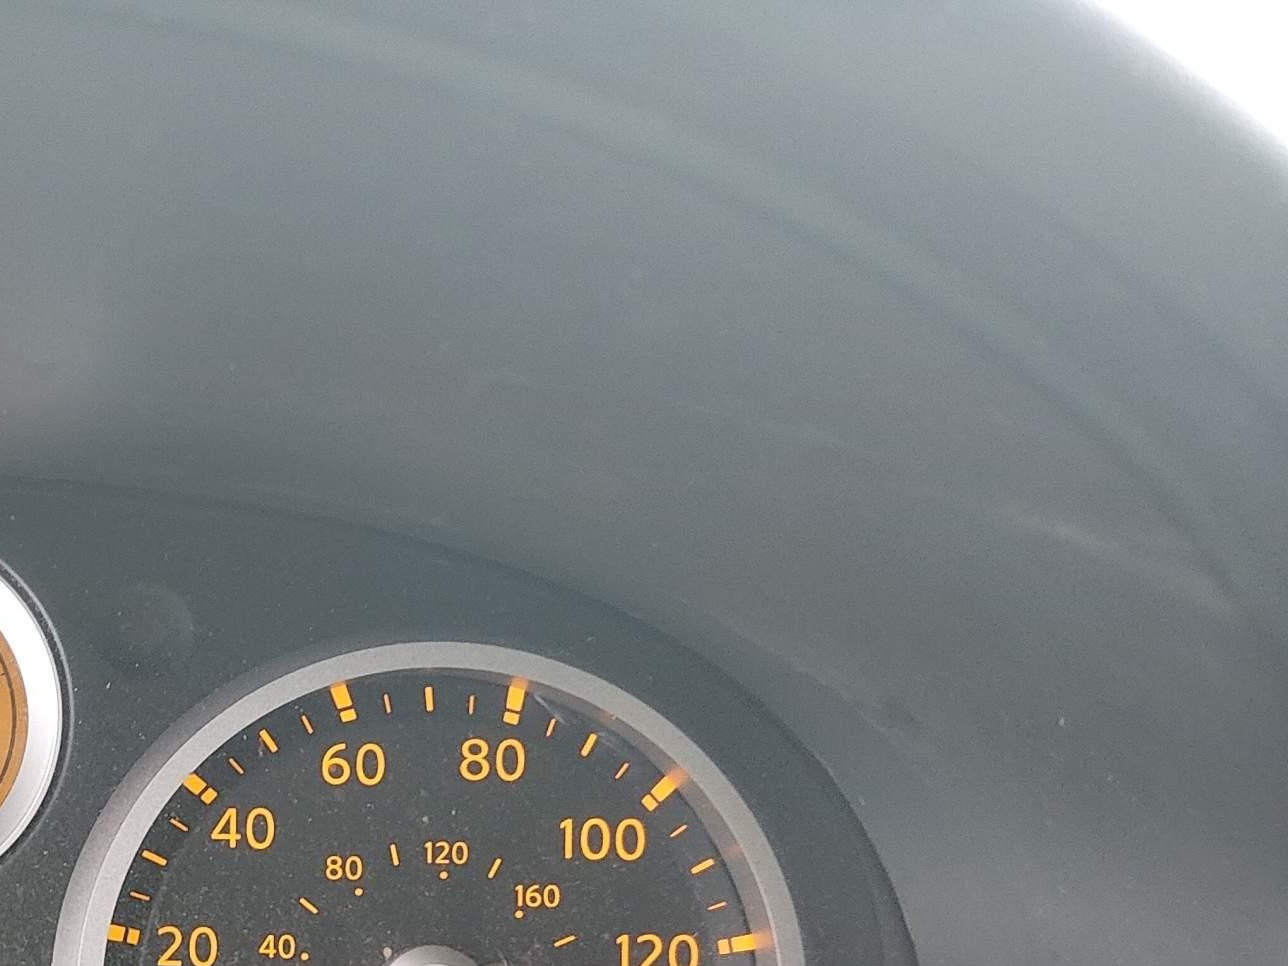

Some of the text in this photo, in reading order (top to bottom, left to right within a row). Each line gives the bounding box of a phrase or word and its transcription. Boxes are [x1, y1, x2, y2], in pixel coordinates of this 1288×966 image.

[320, 742, 386, 786] 60
[459, 738, 526, 783] 80
[211, 806, 275, 850] 40
[560, 817, 646, 861] 100
[325, 855, 363, 882] 80
[424, 840, 468, 866] 120
[515, 883, 560, 909] 160
[258, 934, 297, 960] 40
